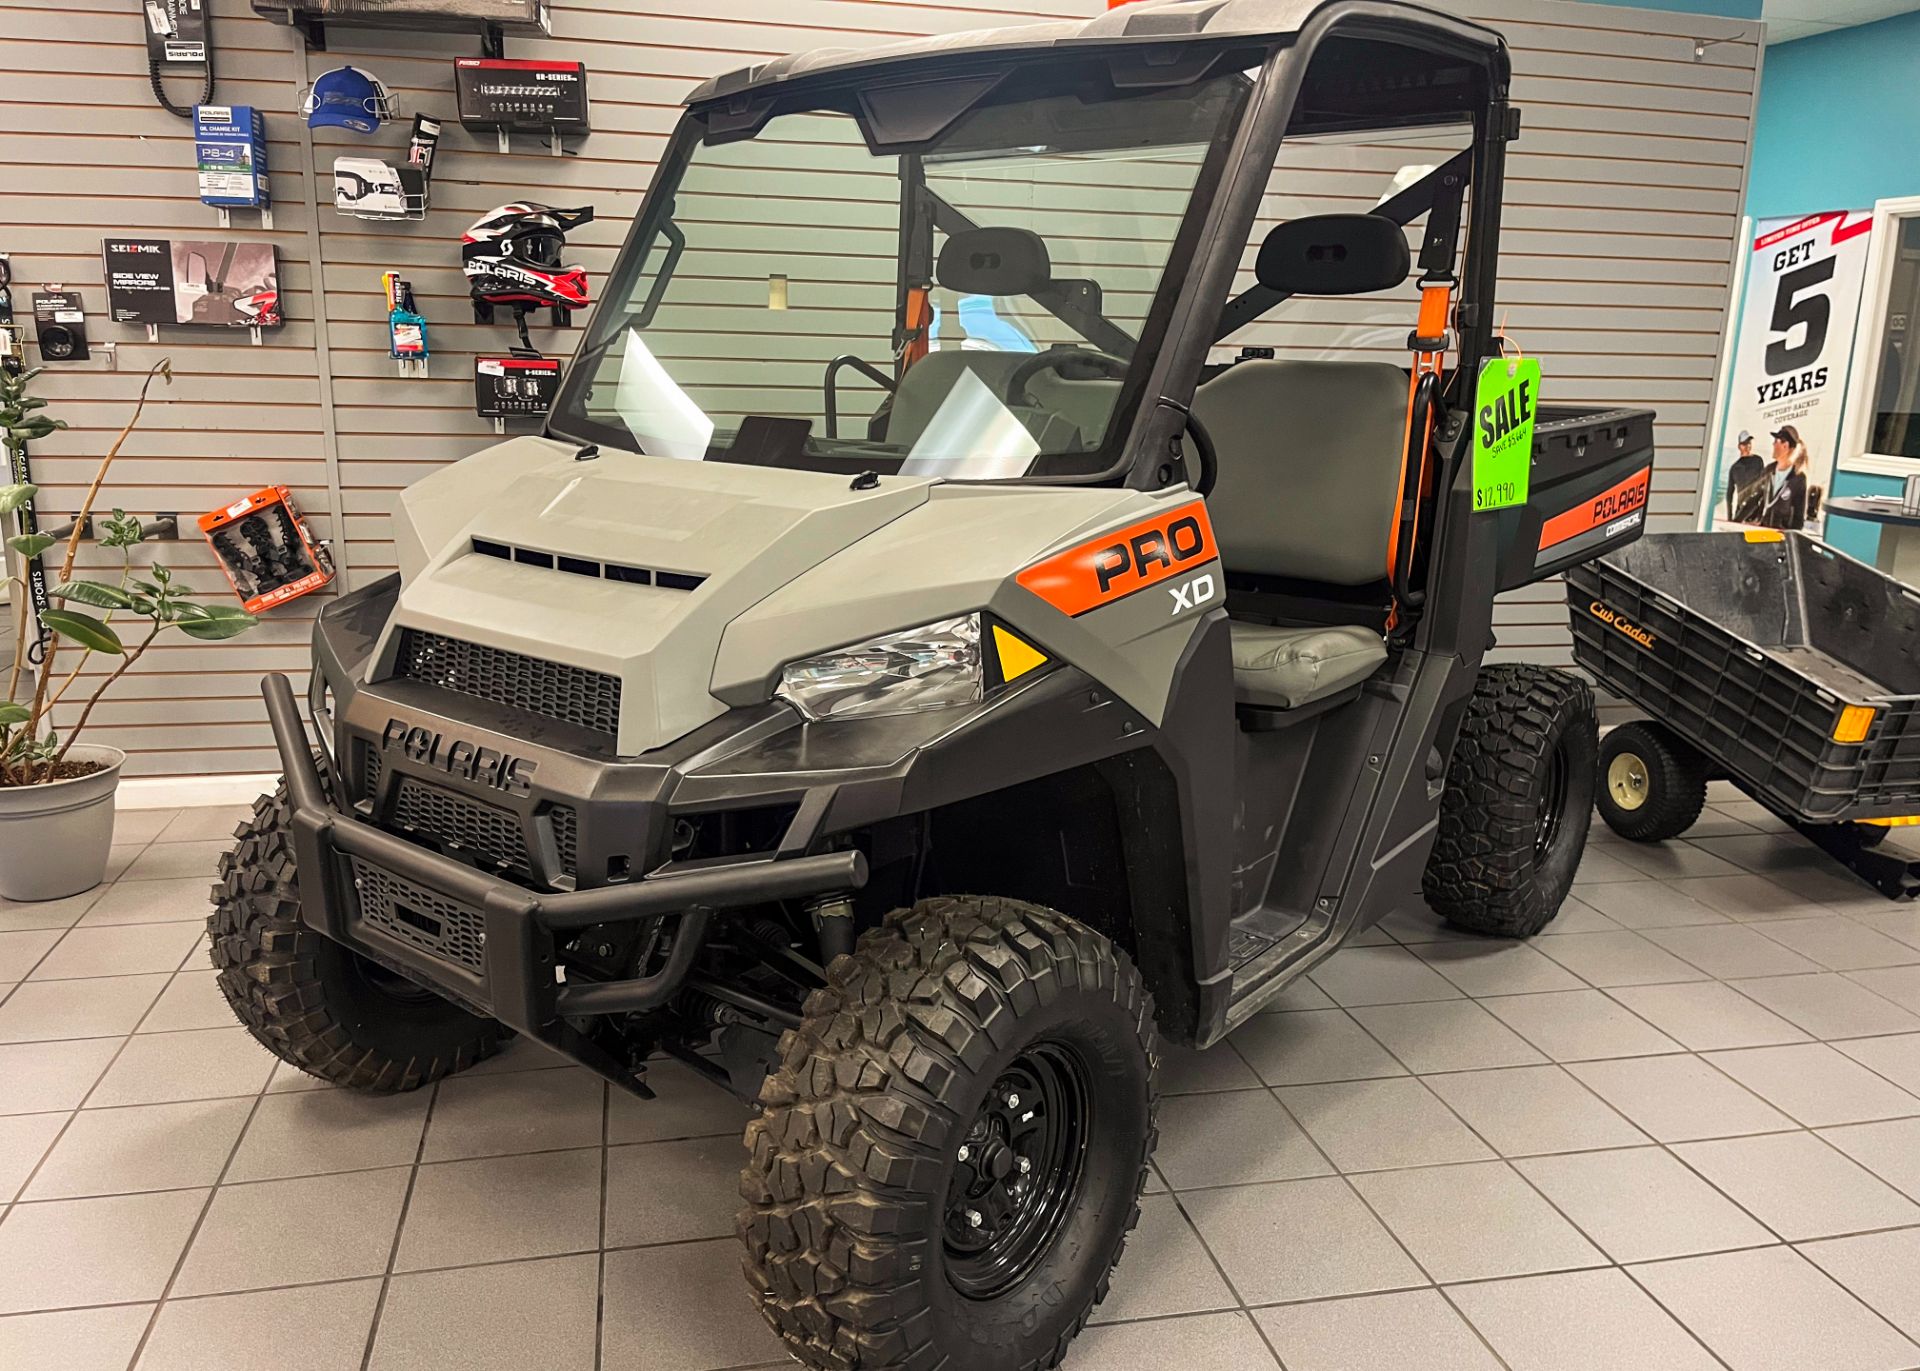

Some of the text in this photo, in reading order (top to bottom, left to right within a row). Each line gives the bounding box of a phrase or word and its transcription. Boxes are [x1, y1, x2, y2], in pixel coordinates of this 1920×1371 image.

[111, 244, 161, 254] SEIZMIK
[1773, 238, 1816, 272] GET
[467, 260, 537, 285] POLARIS
[1764, 254, 1837, 376] 5
[1757, 366, 1828, 404] YEARS
[1479, 378, 1532, 449] SALE
[1774, 409, 1809, 424] COVERAGE
[1491, 440, 1507, 459] SAVE
[1593, 482, 1645, 524] POLARIS
[1094, 515, 1204, 594] PRO
[32, 571, 46, 606] SPORTS
[1167, 573, 1215, 616] XD
[1589, 601, 1657, 649] Cub Cadet
[382, 718, 540, 798] POLARIS
